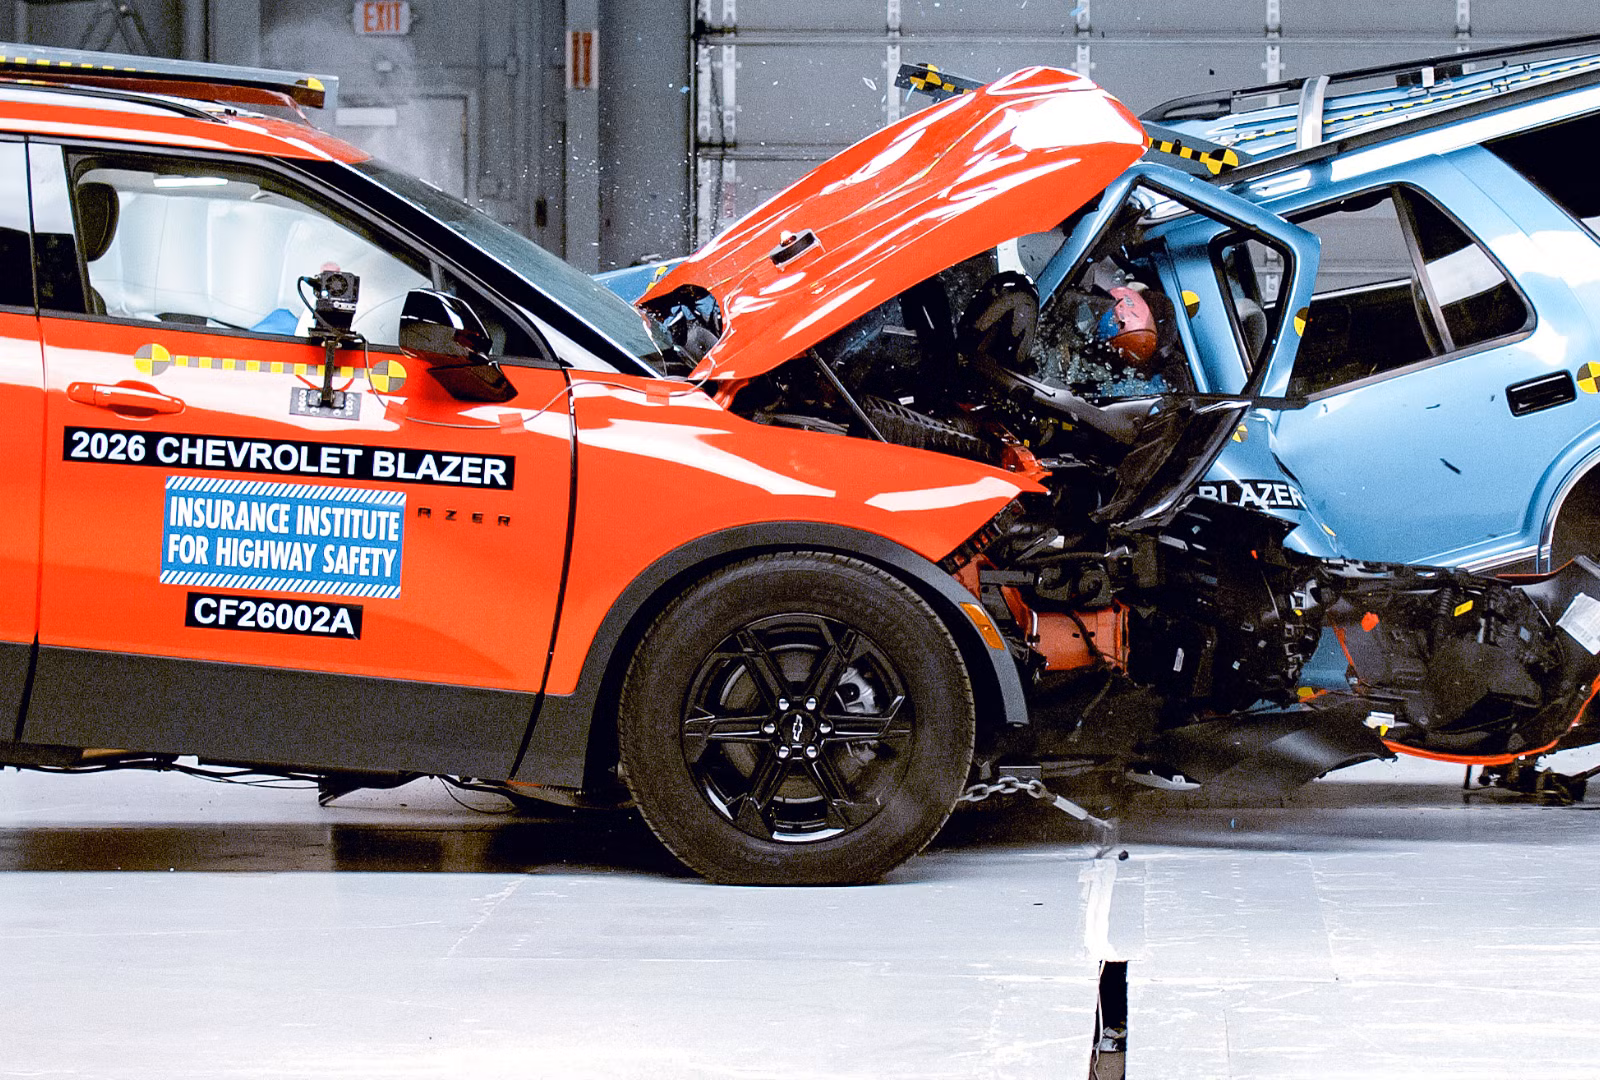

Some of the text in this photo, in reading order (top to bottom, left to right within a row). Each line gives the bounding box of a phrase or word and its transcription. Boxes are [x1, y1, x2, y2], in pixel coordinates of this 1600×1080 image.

[363, 2, 401, 32] EXIT
[70, 432, 507, 486] 2026 CHEVROLET BLAZER
[169, 497, 400, 541] INSURANCE INSTITUTE
[167, 534, 397, 577] FOR HIGHWAY SAFETY
[194, 598, 354, 634] CF26002A
